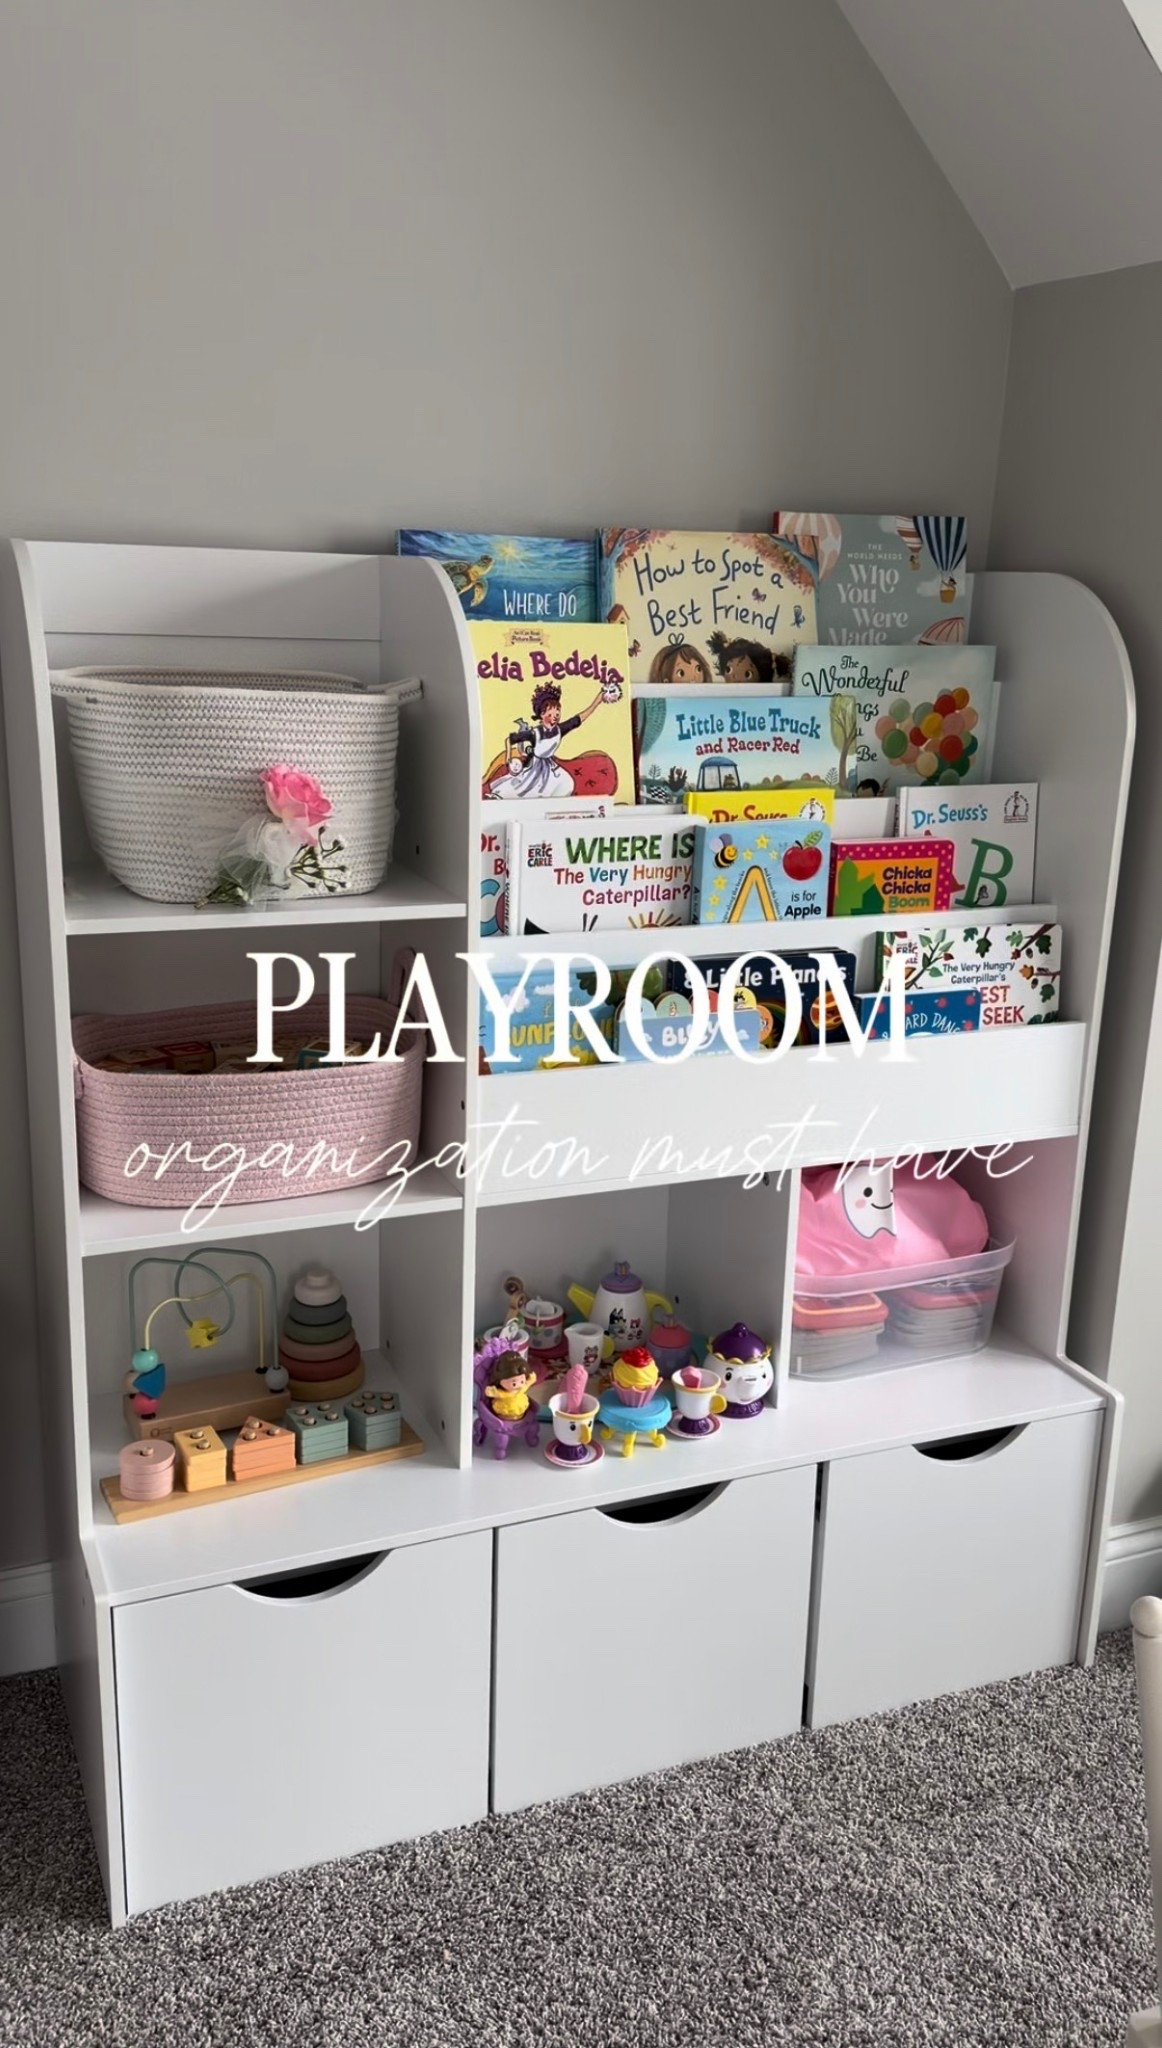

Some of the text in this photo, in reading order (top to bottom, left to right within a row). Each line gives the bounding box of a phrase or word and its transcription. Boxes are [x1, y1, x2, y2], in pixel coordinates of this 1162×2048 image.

[847, 552, 903, 560] WORLD NEEDS
[868, 543, 882, 551] THE
[633, 548, 784, 596] How to Spot a
[848, 563, 900, 594] Who
[503, 589, 577, 617] WHERE DO
[836, 583, 877, 604] You
[647, 585, 780, 636] Best Friend
[852, 607, 909, 628] Were
[828, 627, 887, 645] Made
[477, 650, 625, 684] elia Bedelia
[840, 655, 860, 670] The
[801, 664, 910, 697] Wonderful
[855, 702, 880, 722] ngs
[676, 708, 821, 741] Little Blue Truck
[695, 736, 801, 757] and Racer Red
[855, 745, 878, 763] Be
[911, 808, 936, 829] Dr.
[938, 802, 988, 823] Seuss's
[527, 846, 553, 858] ERIC
[565, 832, 695, 864] WHERE IS
[527, 857, 553, 867] CARLE
[553, 864, 693, 886] The Very Hungry
[882, 866, 933, 881] Chicka
[582, 884, 691, 907] Caterpillar?
[790, 889, 817, 902] is for
[881, 880, 932, 895] Chicka
[784, 903, 822, 919] Apple
[888, 896, 931, 908] Boom
[942, 960, 1016, 974] The Very Hungry
[706, 966, 763, 989] Litle
[950, 972, 1006, 987] Caterpillar's
[979, 985, 1011, 1005] EST
[905, 1012, 928, 1030] ARD
[982, 1004, 1025, 1026] SEEK
